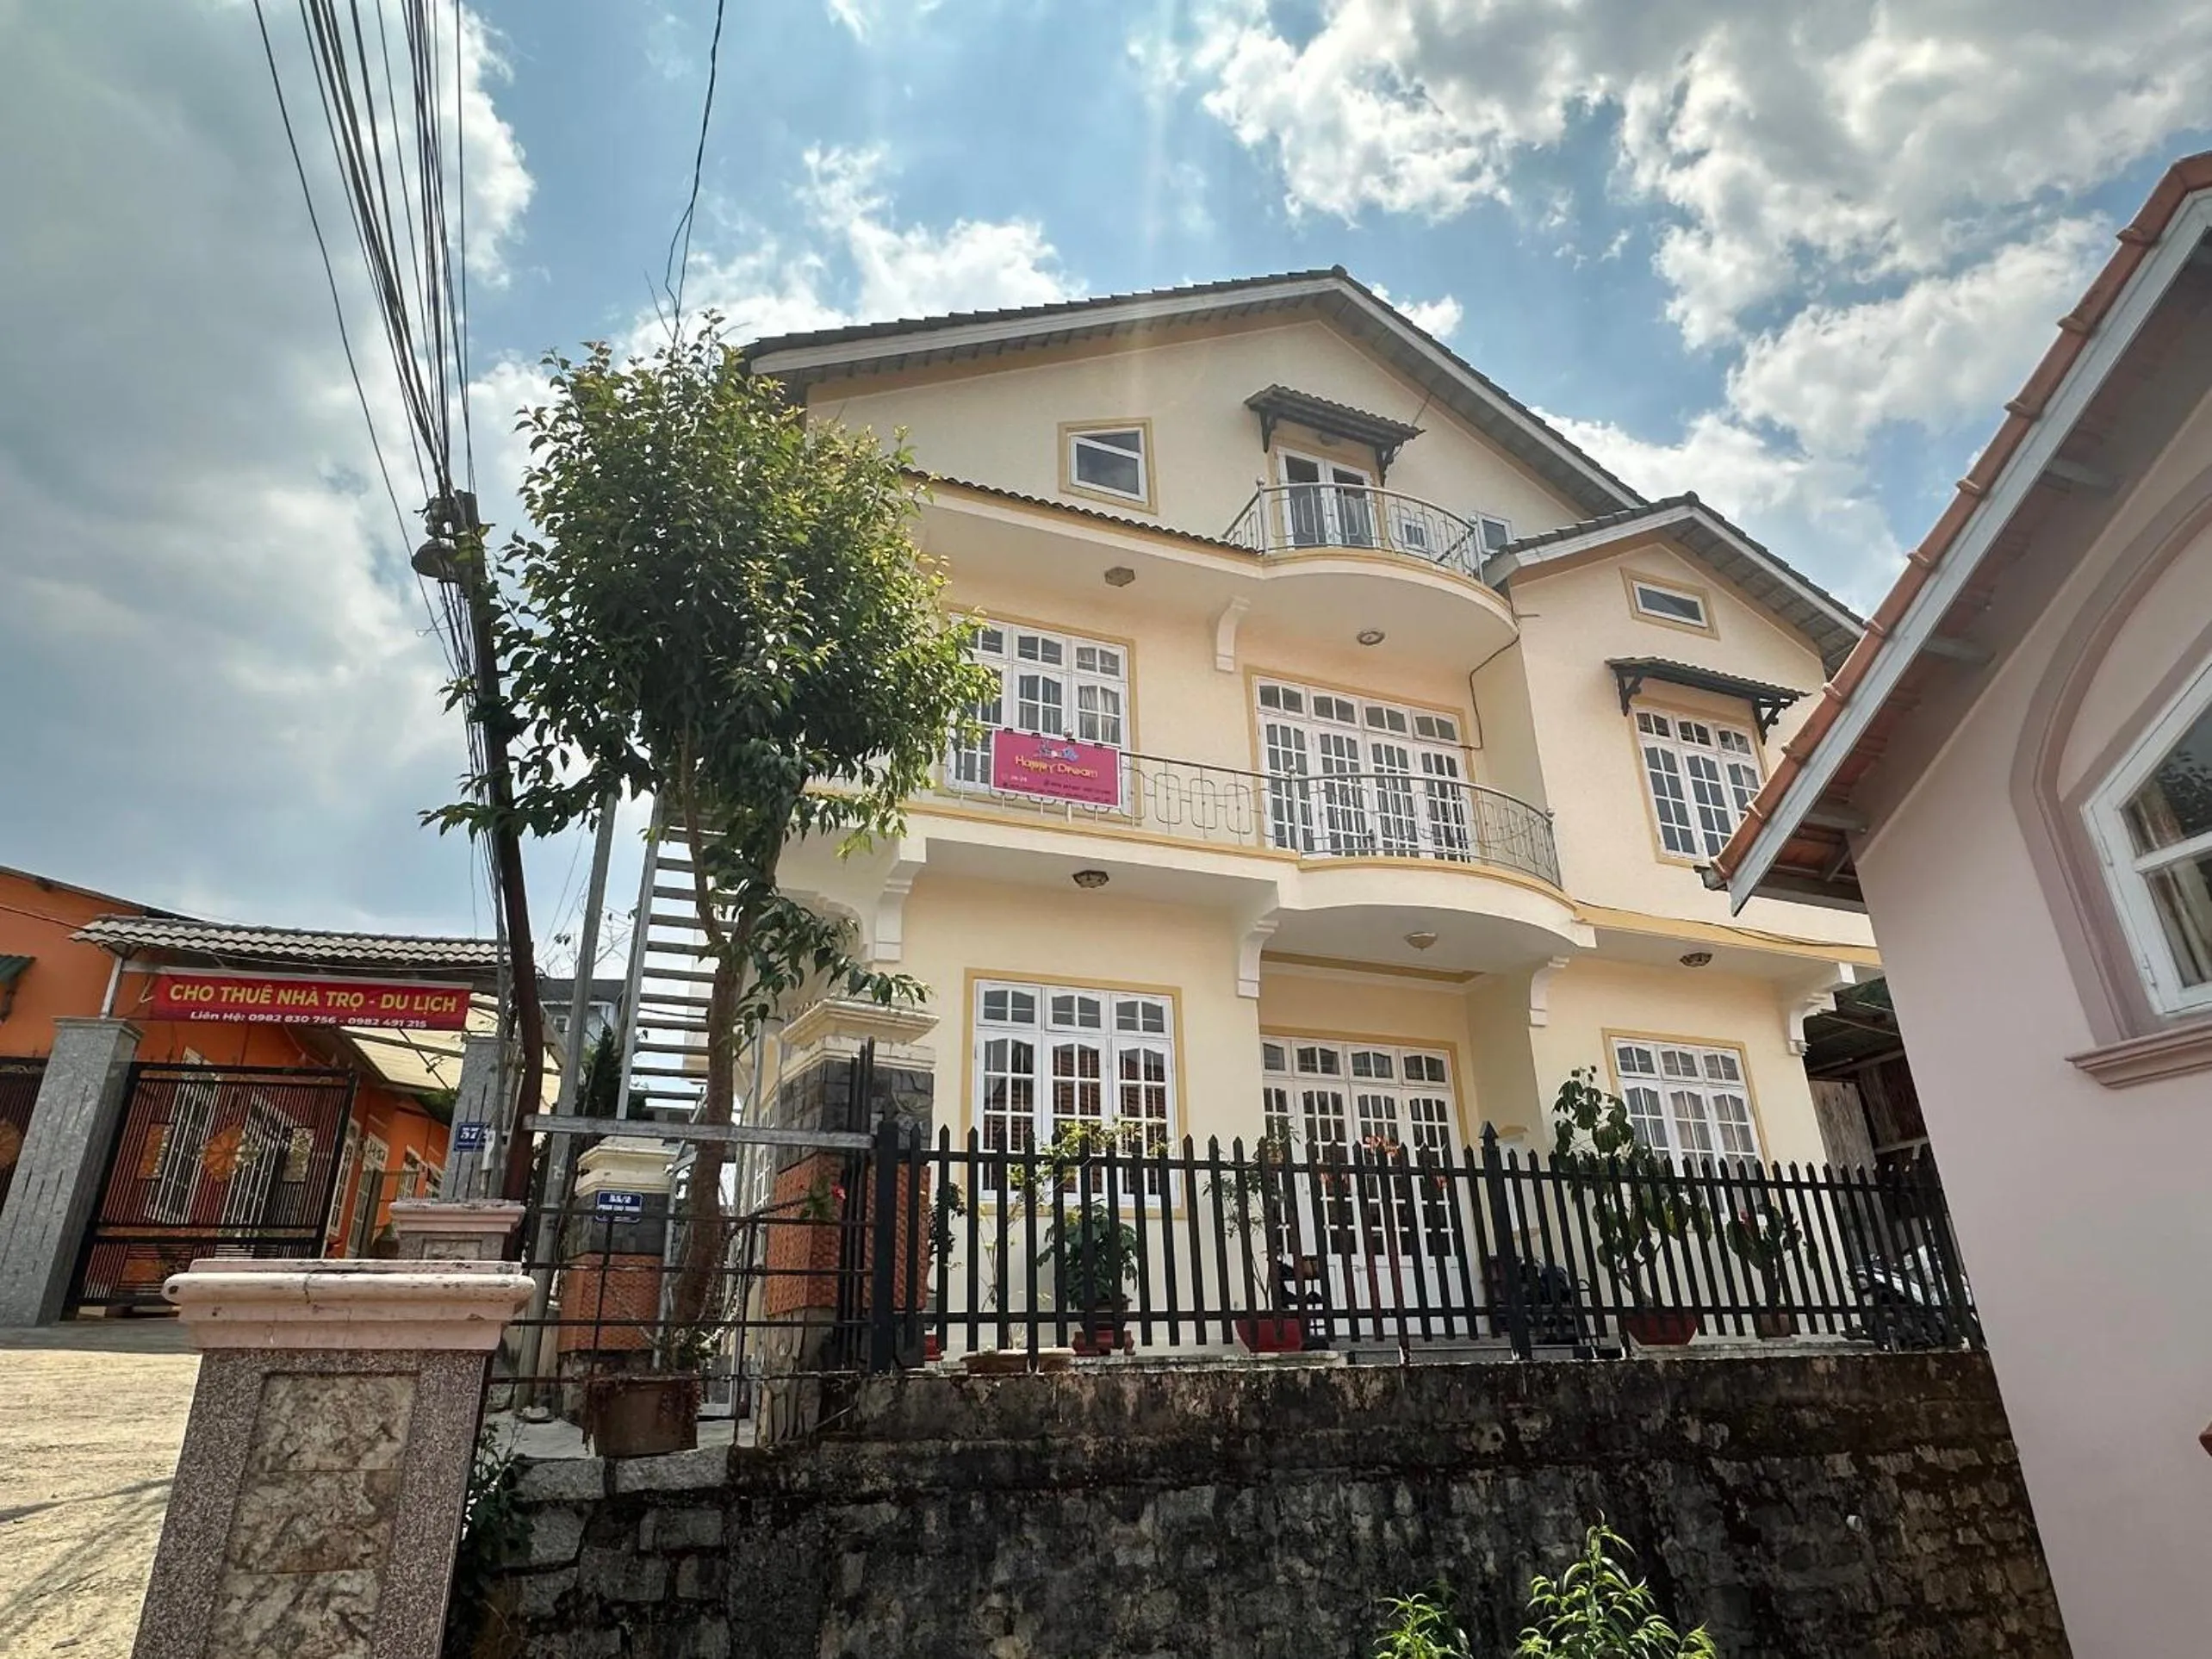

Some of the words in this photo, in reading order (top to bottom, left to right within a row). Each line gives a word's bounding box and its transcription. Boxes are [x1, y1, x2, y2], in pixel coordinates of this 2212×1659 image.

[170, 985, 214, 1002] CHO
[220, 985, 274, 1004] THUÊ
[276, 986, 320, 1006] NHÀ
[326, 991, 364, 1012] TRỌ
[380, 994, 410, 1010] DU
[413, 996, 457, 1015] LỊCH
[190, 1011, 220, 1021] Liên
[248, 1015, 282, 1023] 0982
[347, 1017, 380, 1026] 0982
